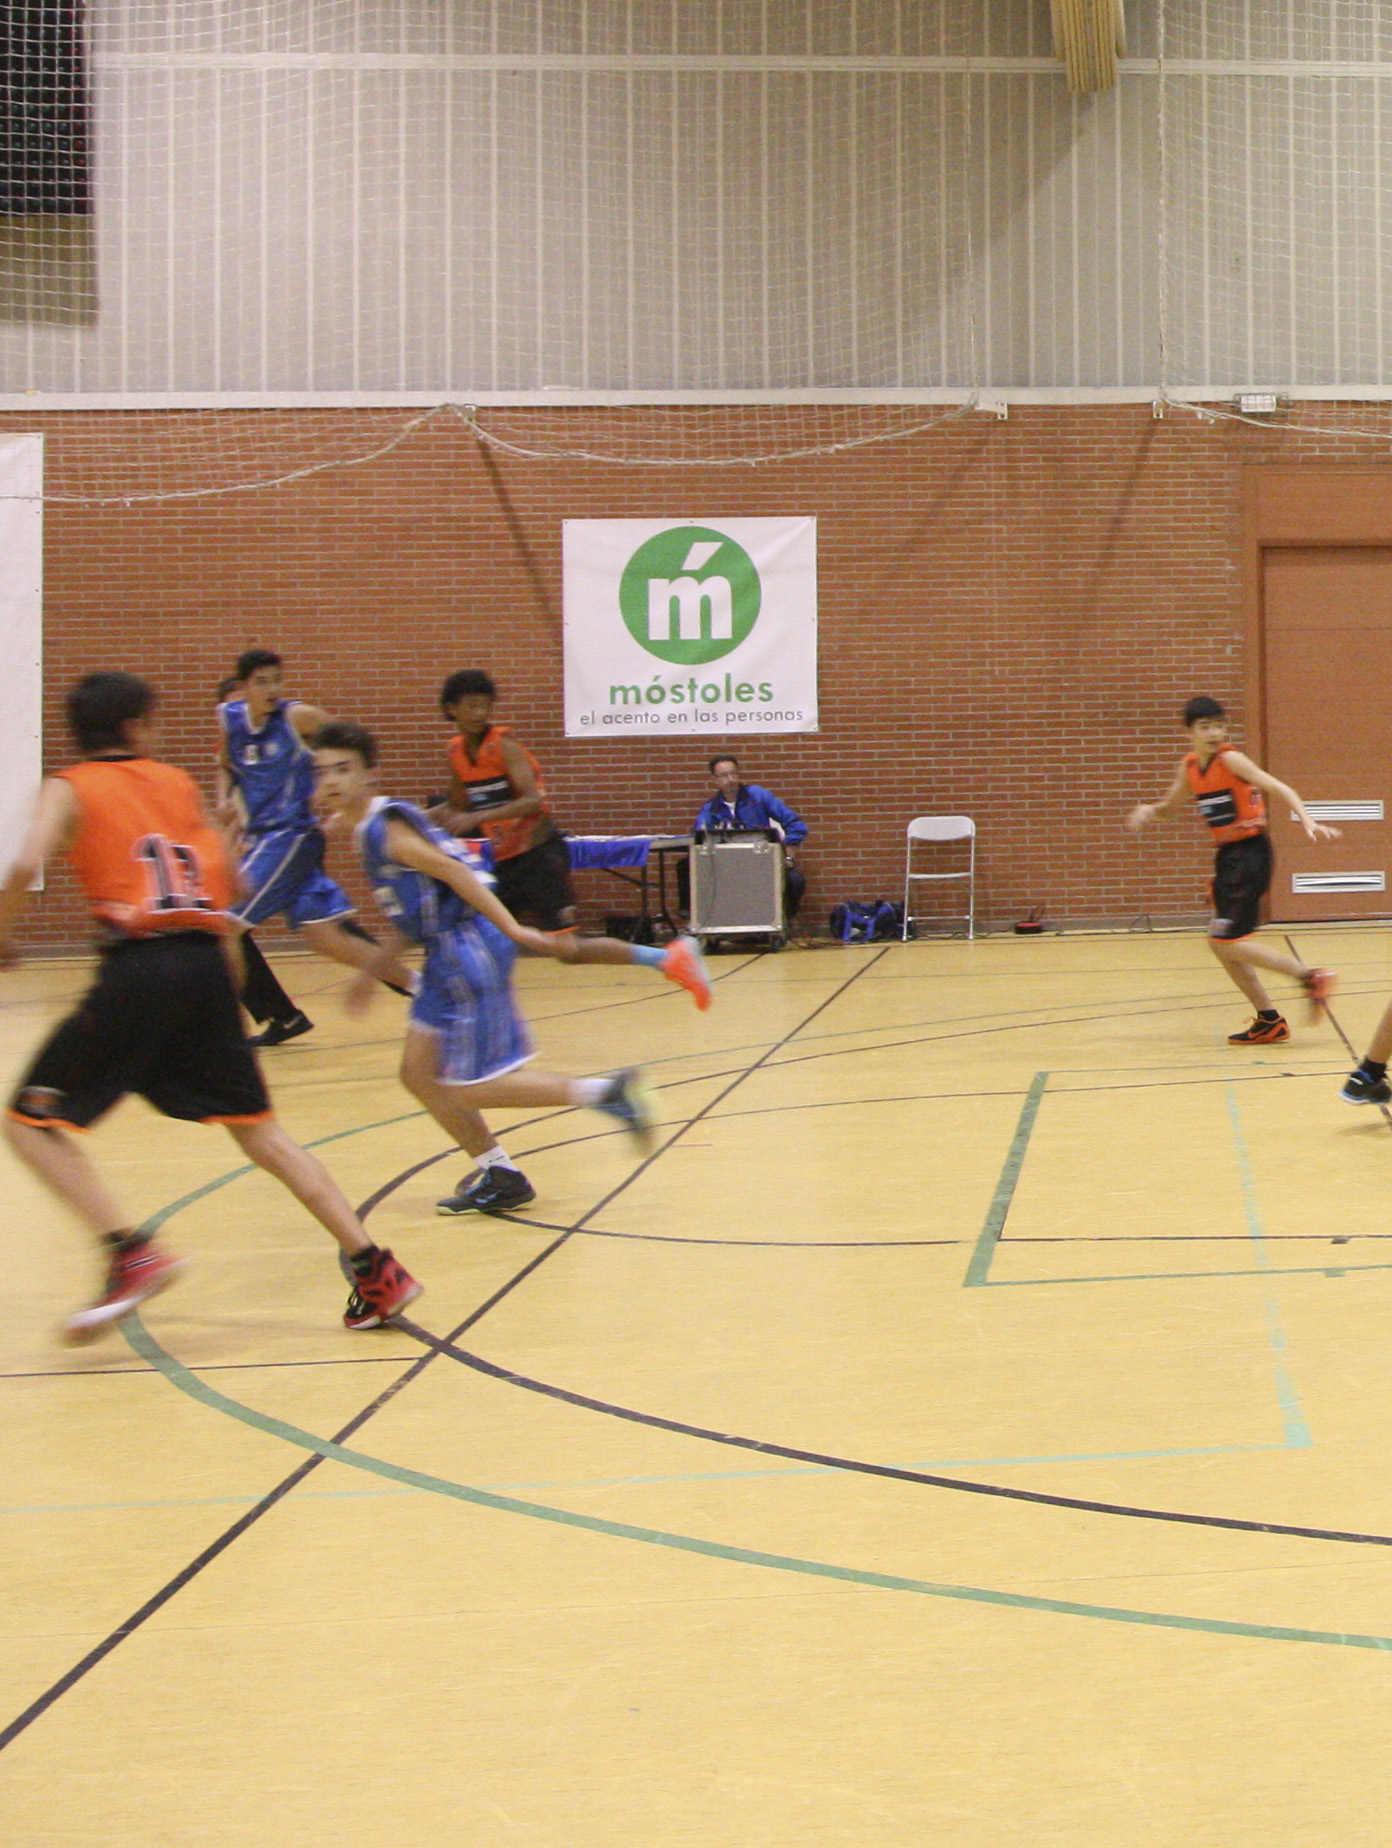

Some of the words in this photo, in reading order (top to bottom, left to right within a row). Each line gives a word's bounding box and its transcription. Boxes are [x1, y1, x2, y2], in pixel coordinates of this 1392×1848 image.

[609, 672, 774, 705] móstoles
[579, 711, 595, 725] el
[602, 712, 661, 725] acento
[667, 713, 688, 724] en
[694, 709, 719, 723] las
[725, 709, 803, 726] personas
